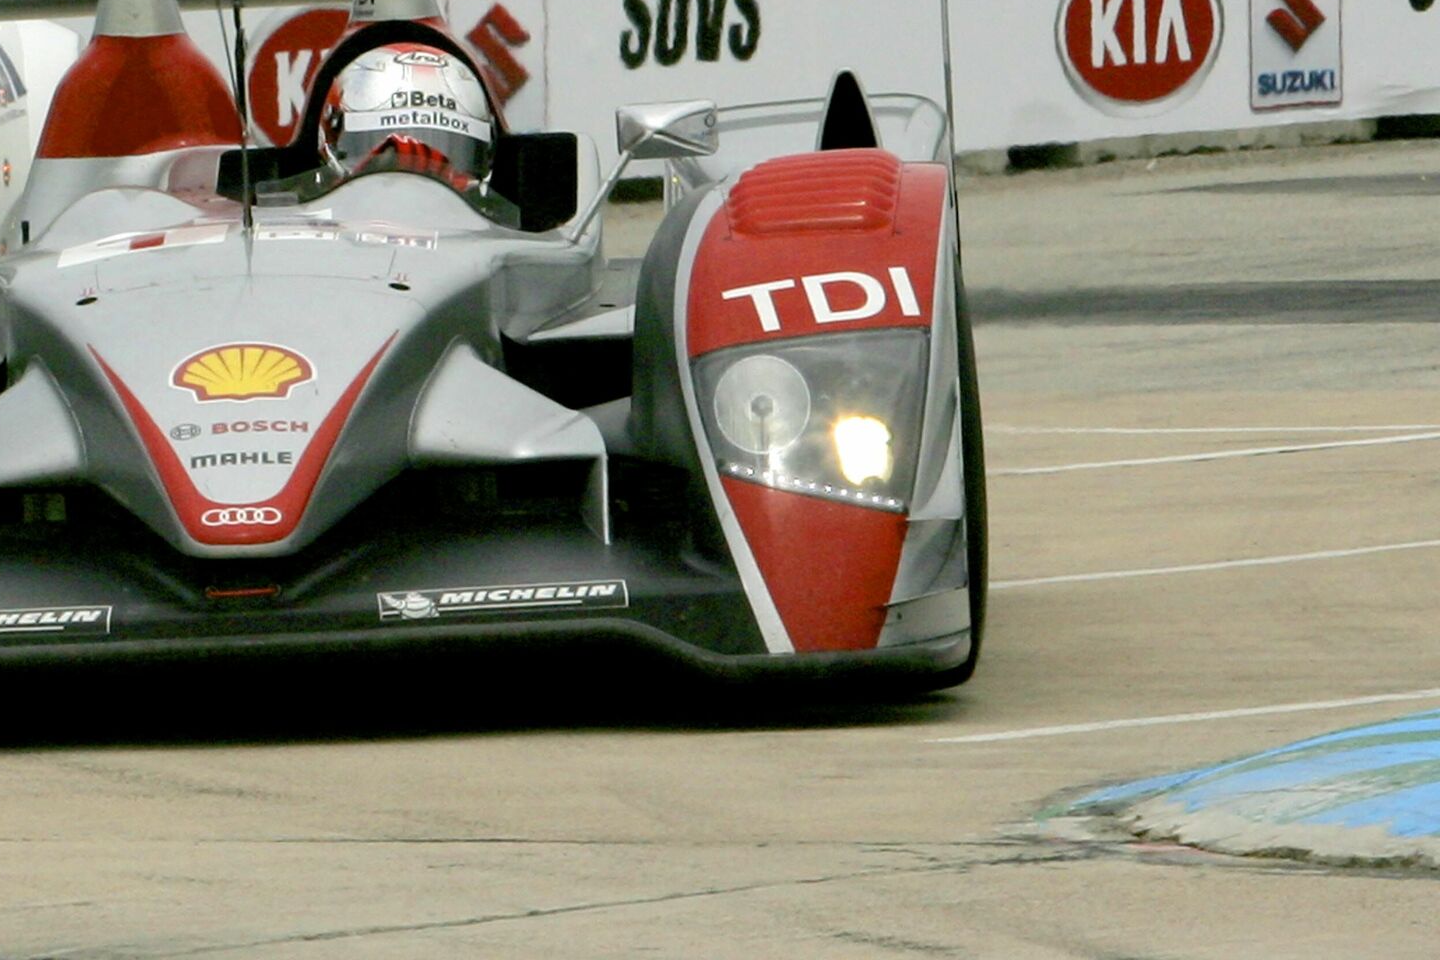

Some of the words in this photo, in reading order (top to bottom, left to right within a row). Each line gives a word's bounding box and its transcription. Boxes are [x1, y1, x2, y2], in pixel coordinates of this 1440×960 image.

[1257, 70, 1336, 96] SUZUKI
[411, 91, 456, 110] Beta
[380, 112, 470, 133] metalbox
[722, 267, 921, 332] TDI
[212, 420, 308, 435] BOSCH
[191, 451, 292, 468] MAHLE
[439, 584, 617, 604] MICHELIN
